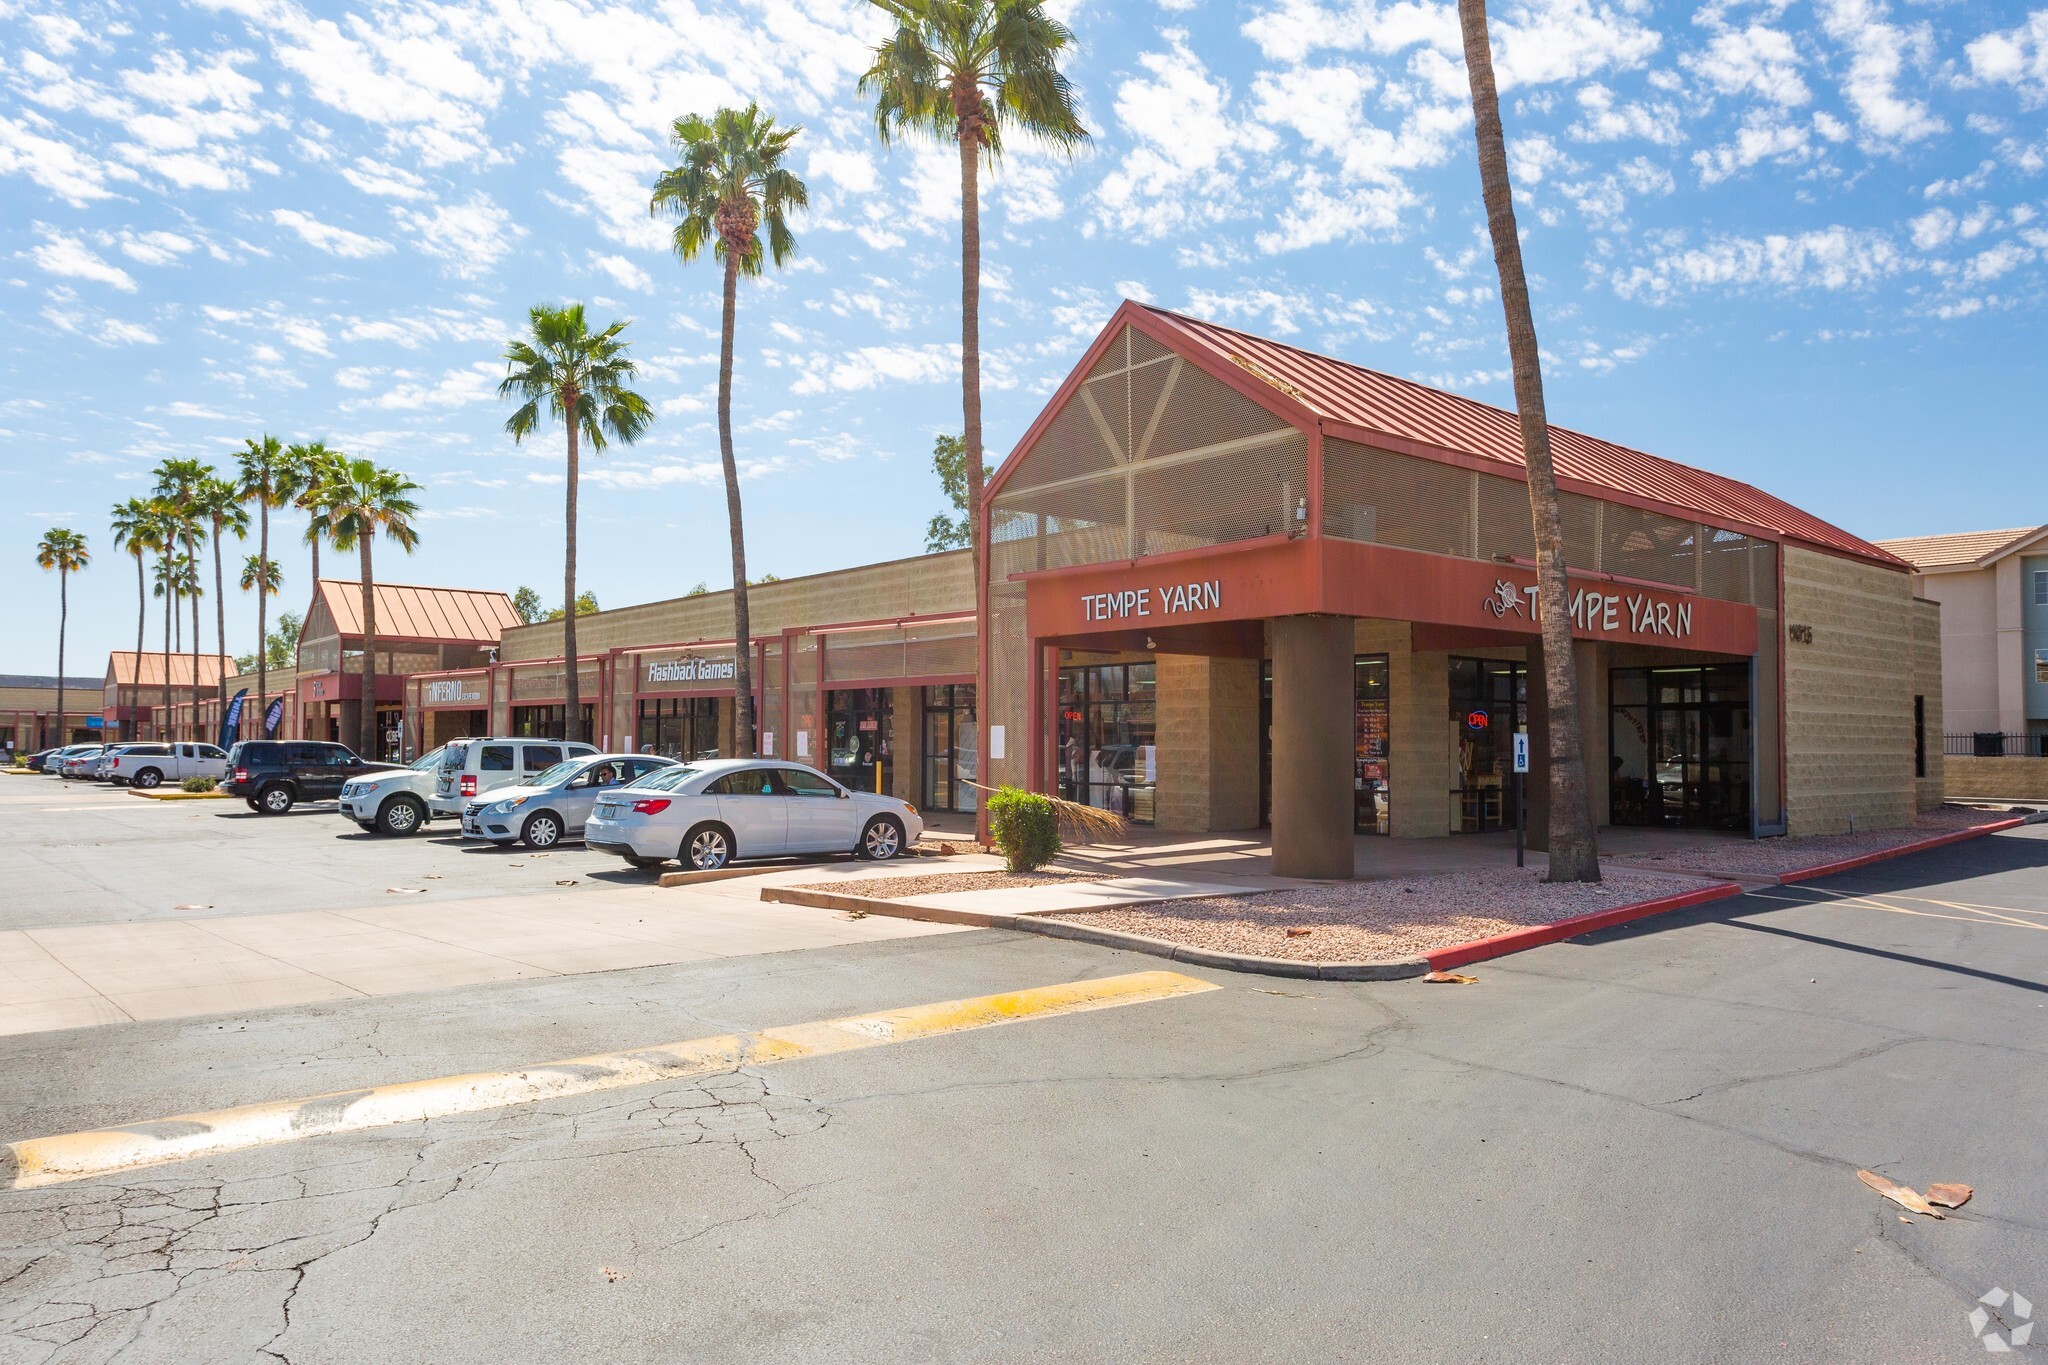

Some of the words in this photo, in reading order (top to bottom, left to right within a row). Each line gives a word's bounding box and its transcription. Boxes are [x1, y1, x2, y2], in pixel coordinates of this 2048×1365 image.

[1081, 588, 1150, 621] TEMPE
[1159, 580, 1221, 614] YARN
[1523, 585, 1619, 632] TMPE
[1626, 593, 1692, 639] YARN
[648, 659, 697, 682] Flashback
[698, 659, 734, 680] Games
[1064, 711, 1082, 721] OPEN
[1468, 713, 1488, 727] OPEN
